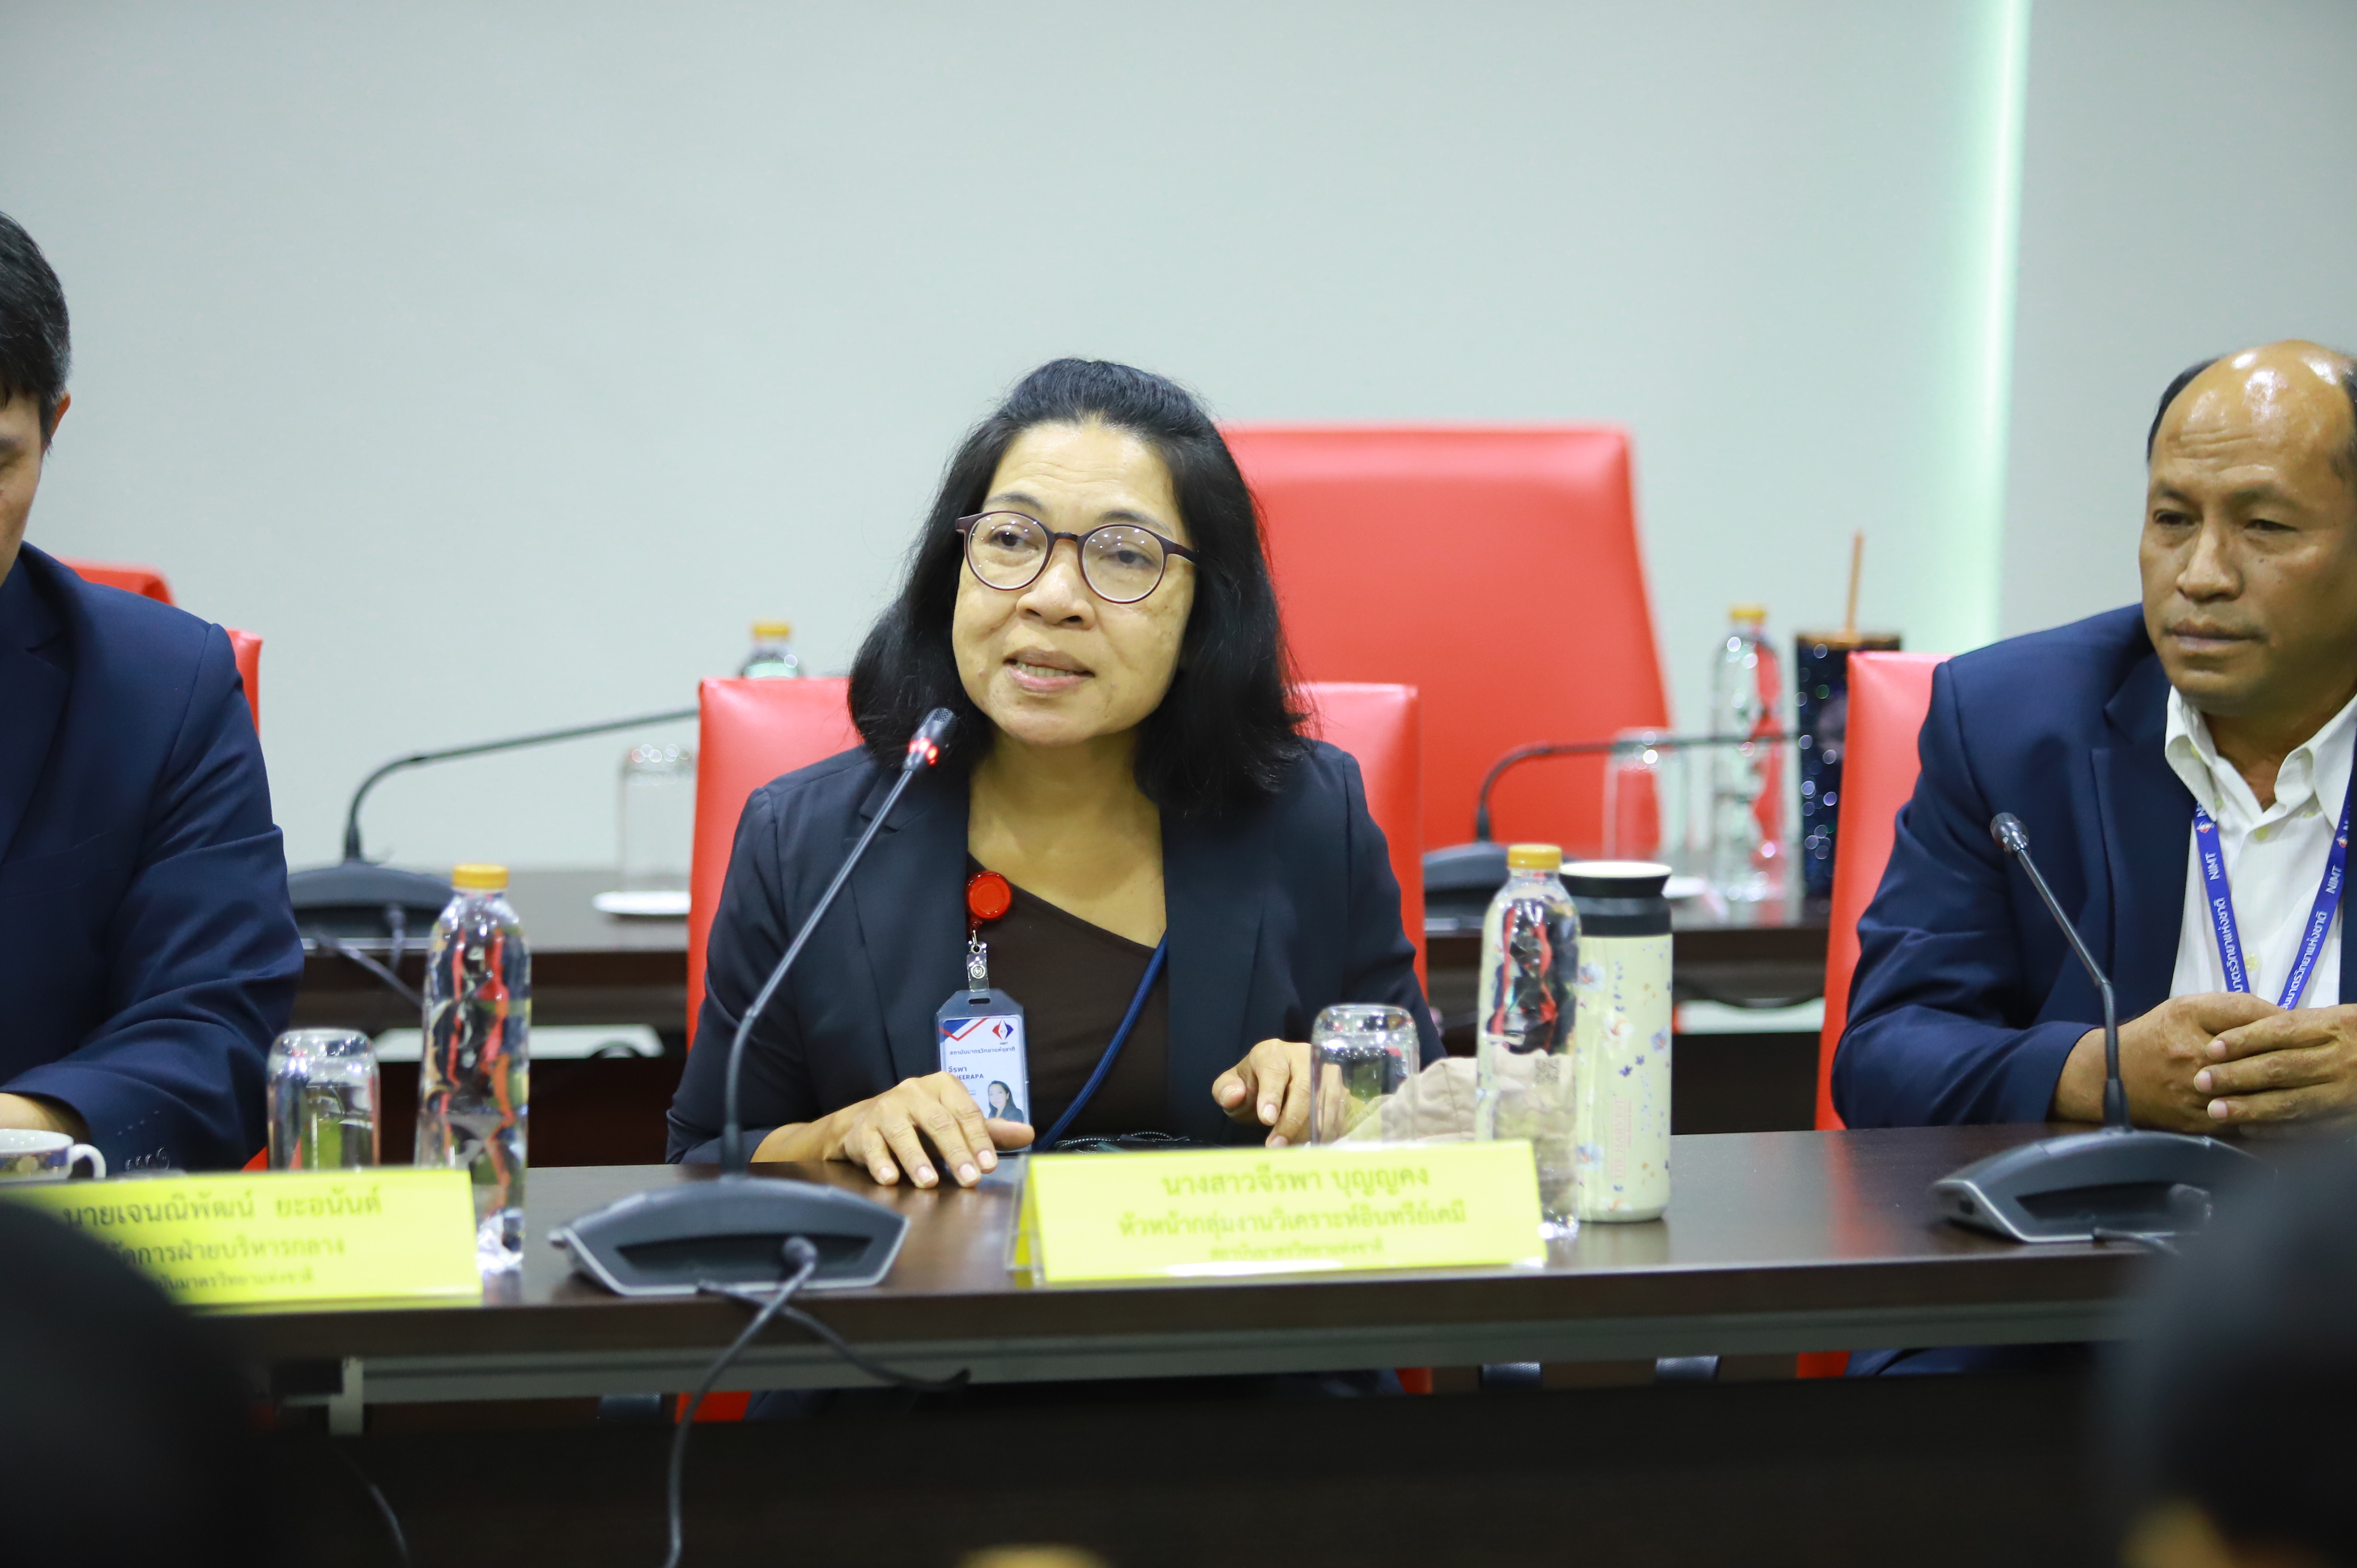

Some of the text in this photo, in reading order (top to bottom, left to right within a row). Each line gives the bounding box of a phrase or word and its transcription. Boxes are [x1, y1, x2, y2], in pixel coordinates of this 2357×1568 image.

[2205, 852, 2220, 880] NIMT
[2325, 864, 2342, 894] NIMT
[1162, 1162, 1322, 1196] นางสาวจีรพา
